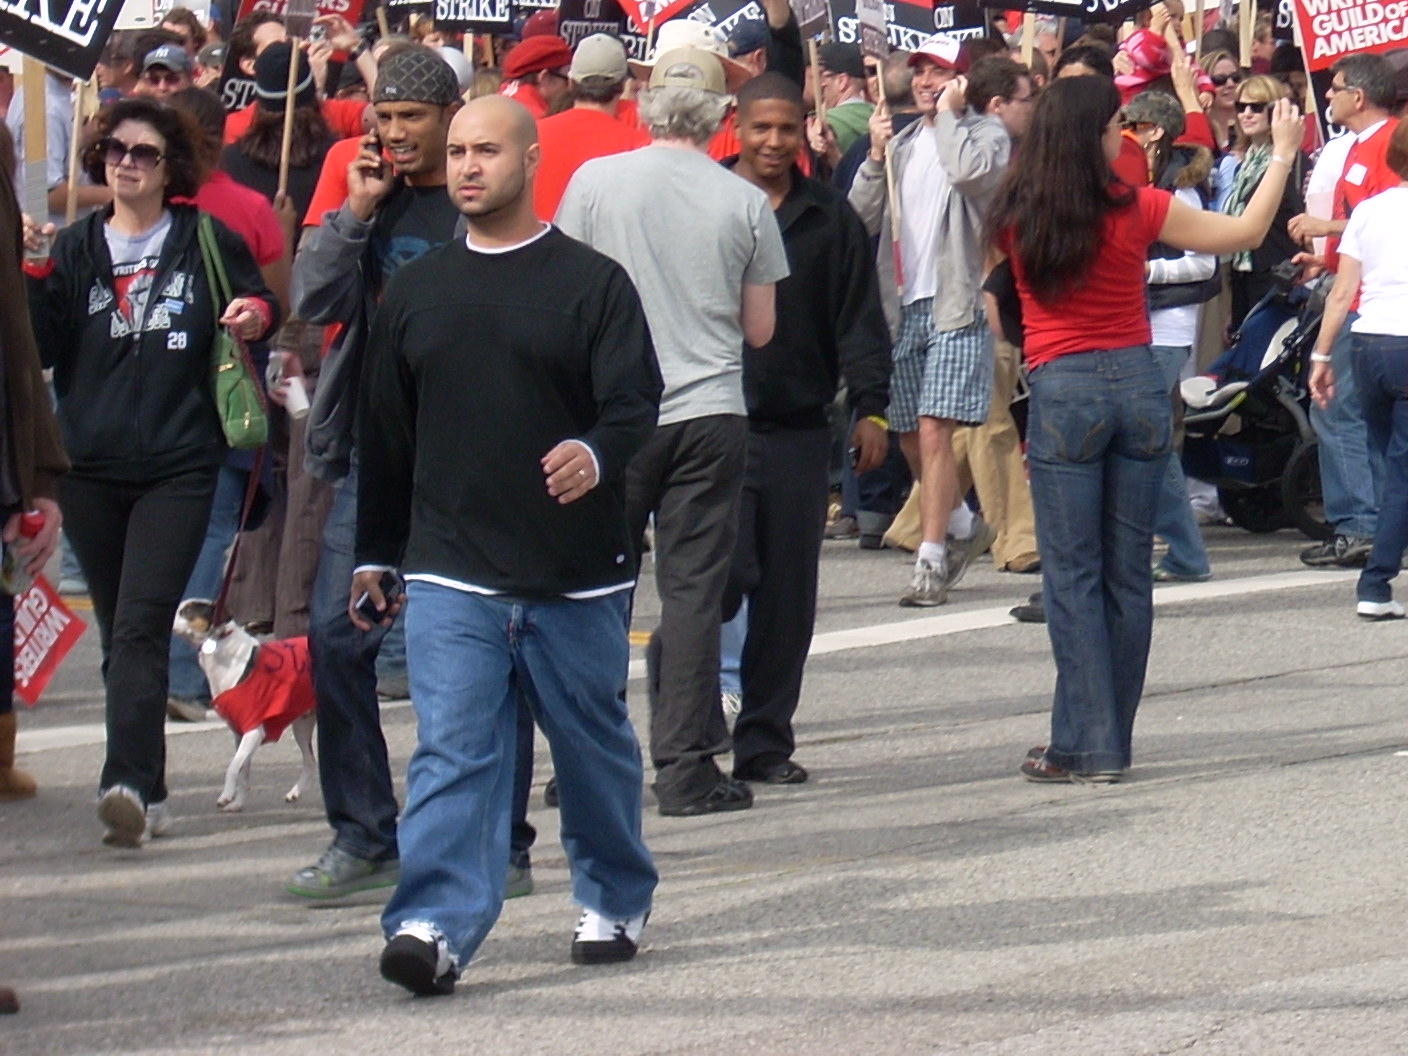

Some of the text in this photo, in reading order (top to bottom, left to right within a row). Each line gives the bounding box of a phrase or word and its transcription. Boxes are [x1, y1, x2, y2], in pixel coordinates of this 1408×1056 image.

[934, 7, 955, 28] ON
[1312, 1, 1408, 37] GUILD OF
